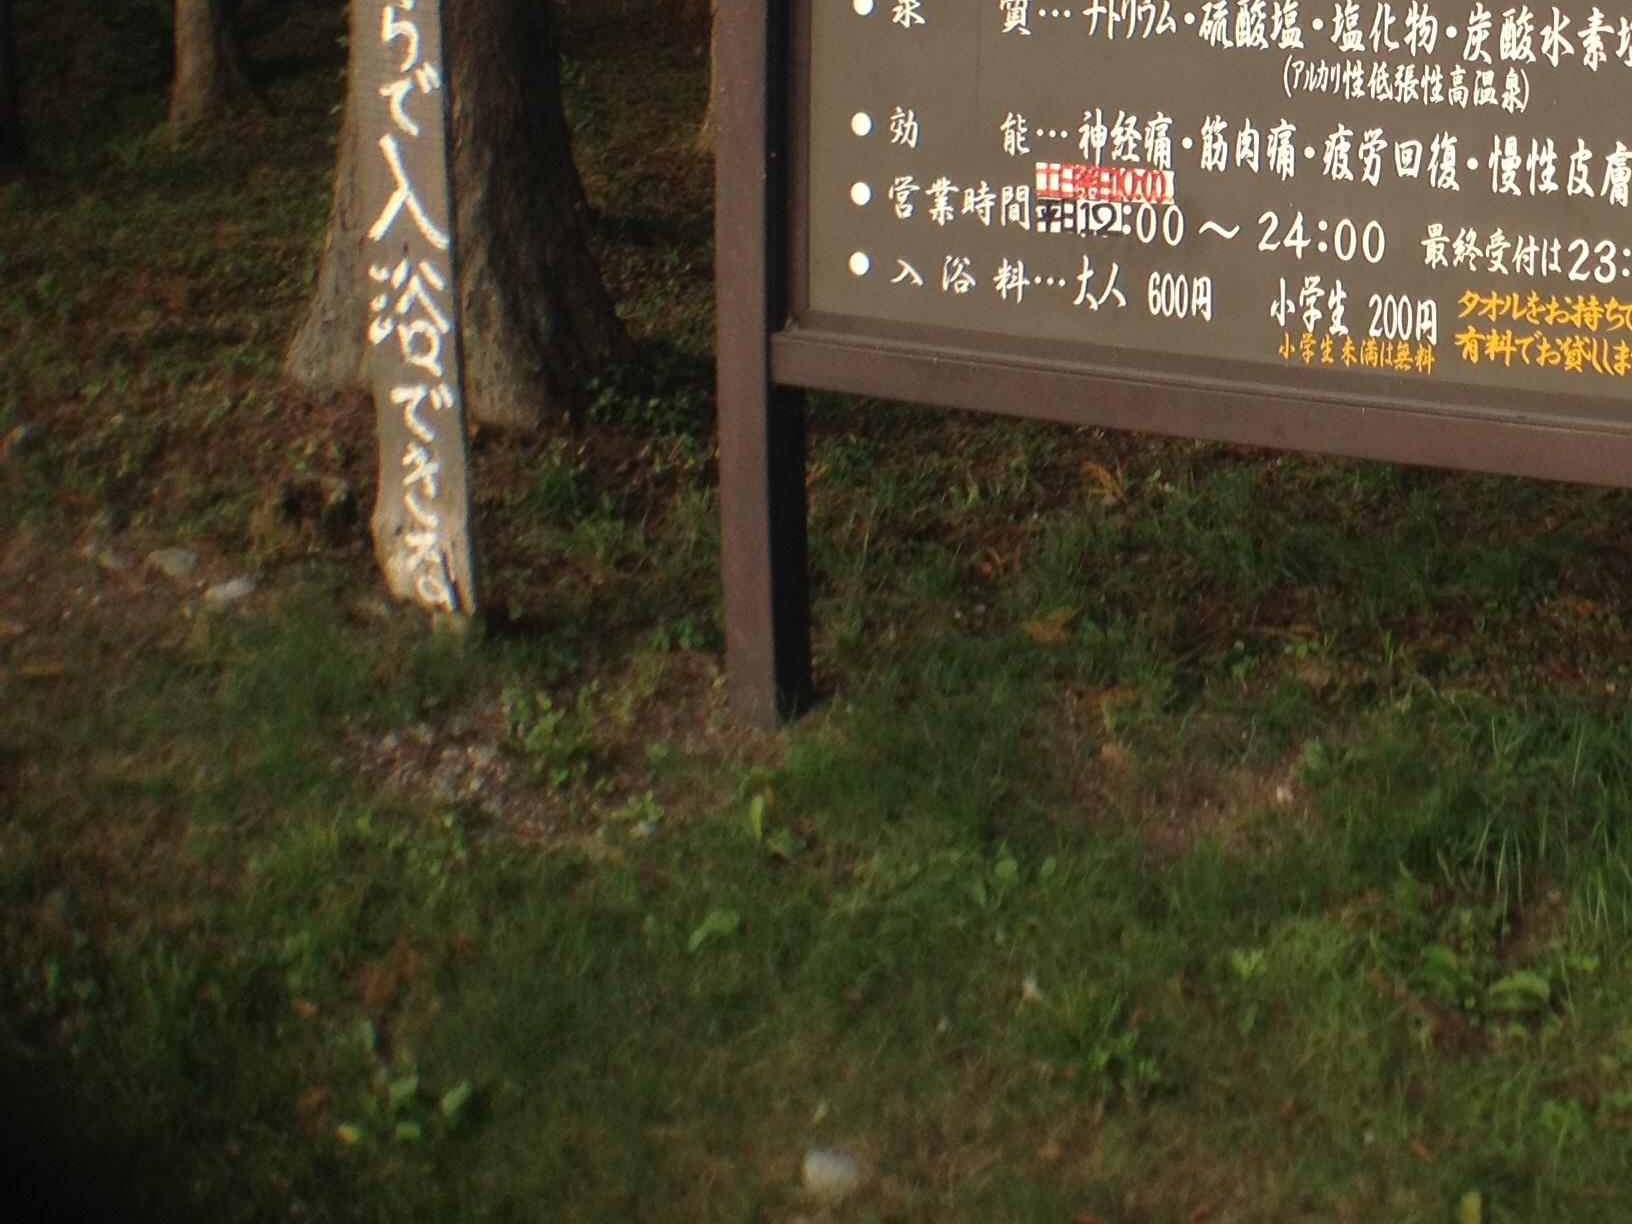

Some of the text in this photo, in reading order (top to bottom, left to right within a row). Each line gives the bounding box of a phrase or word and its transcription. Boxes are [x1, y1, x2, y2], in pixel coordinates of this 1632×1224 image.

[1148, 271, 1213, 322] 600円
[1270, 275, 1349, 336] 小学生
[1368, 293, 1438, 346] 200円
[1278, 332, 1436, 376] 小学生未満は無料
